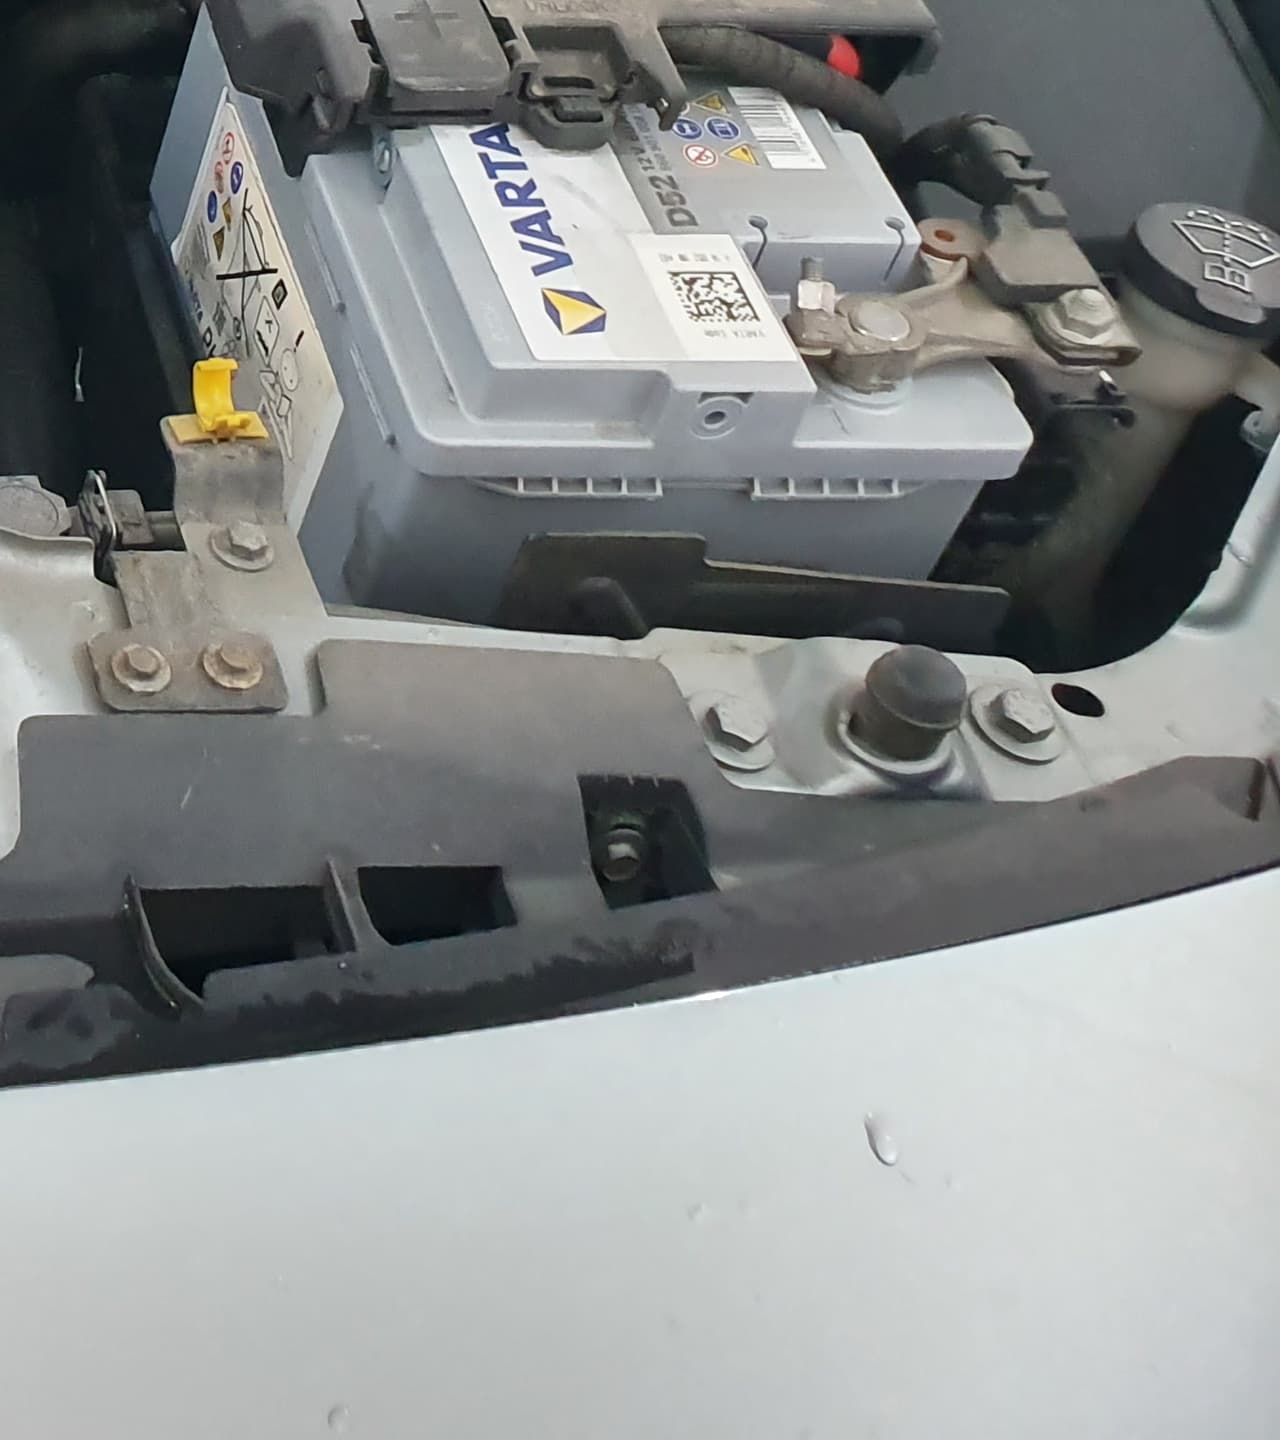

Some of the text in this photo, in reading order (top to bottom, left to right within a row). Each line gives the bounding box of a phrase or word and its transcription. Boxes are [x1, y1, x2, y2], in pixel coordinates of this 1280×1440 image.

[639, 157, 655, 172] 12
[469, 121, 574, 277] VARTA
[648, 175, 698, 227] D52
